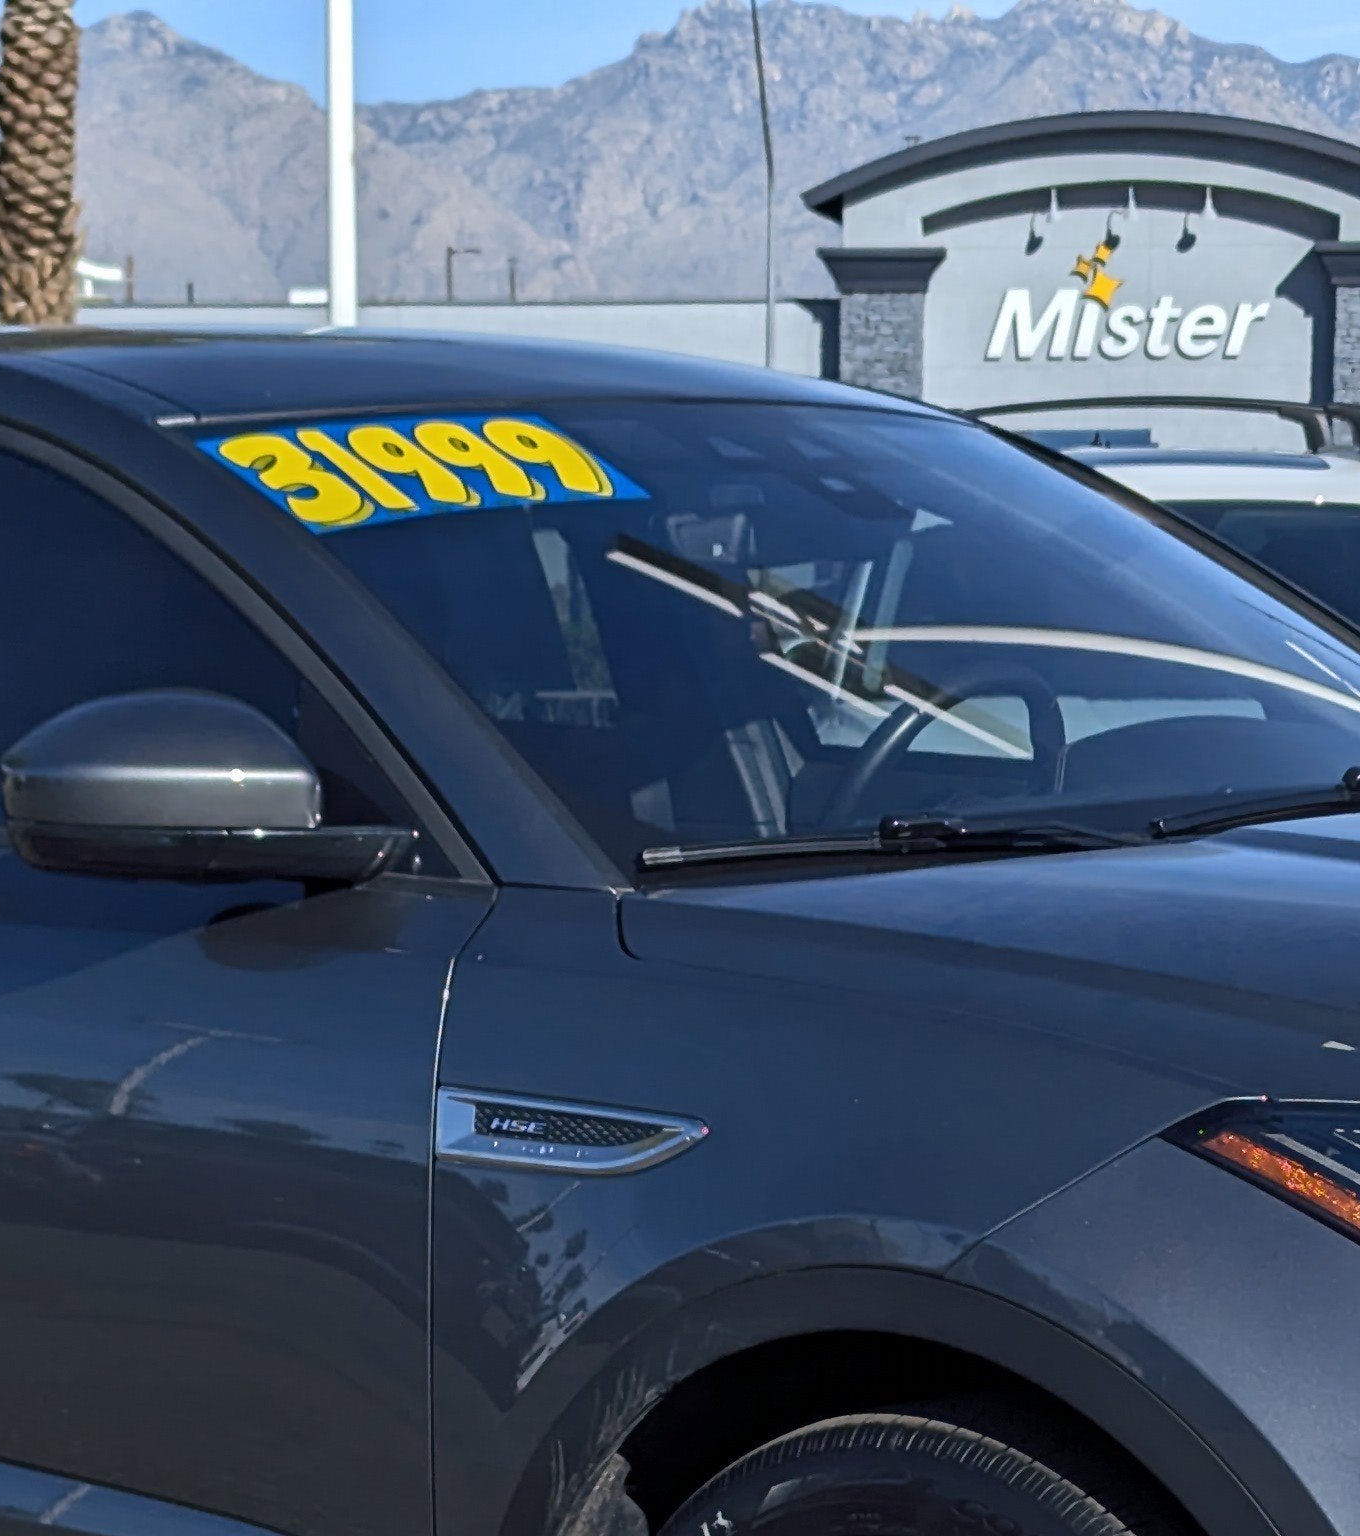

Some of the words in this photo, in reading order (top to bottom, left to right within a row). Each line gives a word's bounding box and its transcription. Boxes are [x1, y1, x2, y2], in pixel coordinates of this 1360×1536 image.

[984, 287, 1270, 362] Mister
[219, 417, 614, 527] 31999
[490, 1117, 546, 1134] HSE
